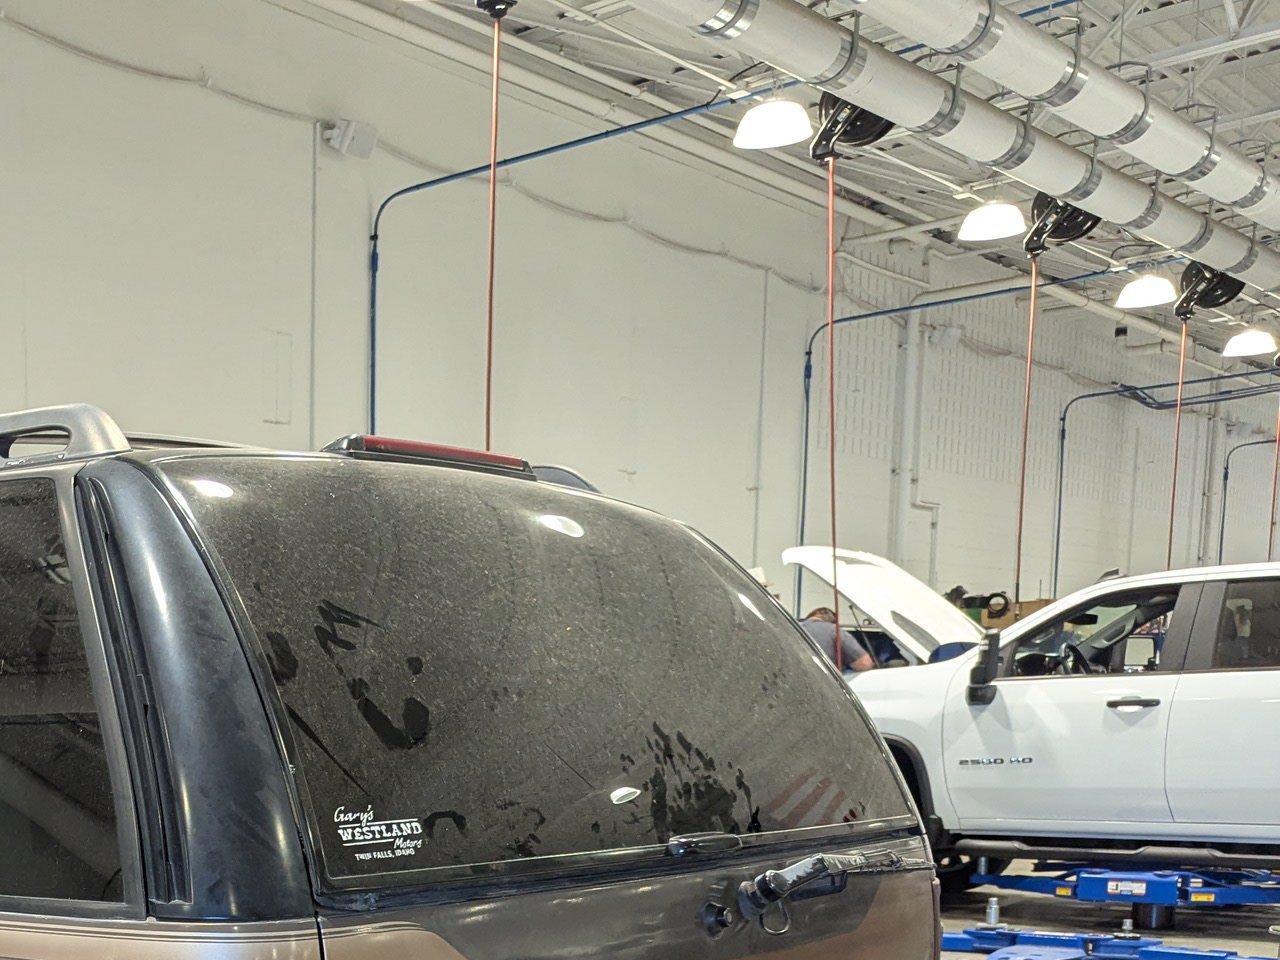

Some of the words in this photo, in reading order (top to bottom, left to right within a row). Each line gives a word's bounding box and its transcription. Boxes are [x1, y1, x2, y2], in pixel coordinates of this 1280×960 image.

[333, 804, 374, 827] Gary's
[337, 821, 423, 841] WESTLAND
[393, 837, 423, 849] Motors
[355, 852, 372, 861] TWIN
[373, 849, 395, 860] FALLS,
[395, 847, 416, 857] IDAHO
